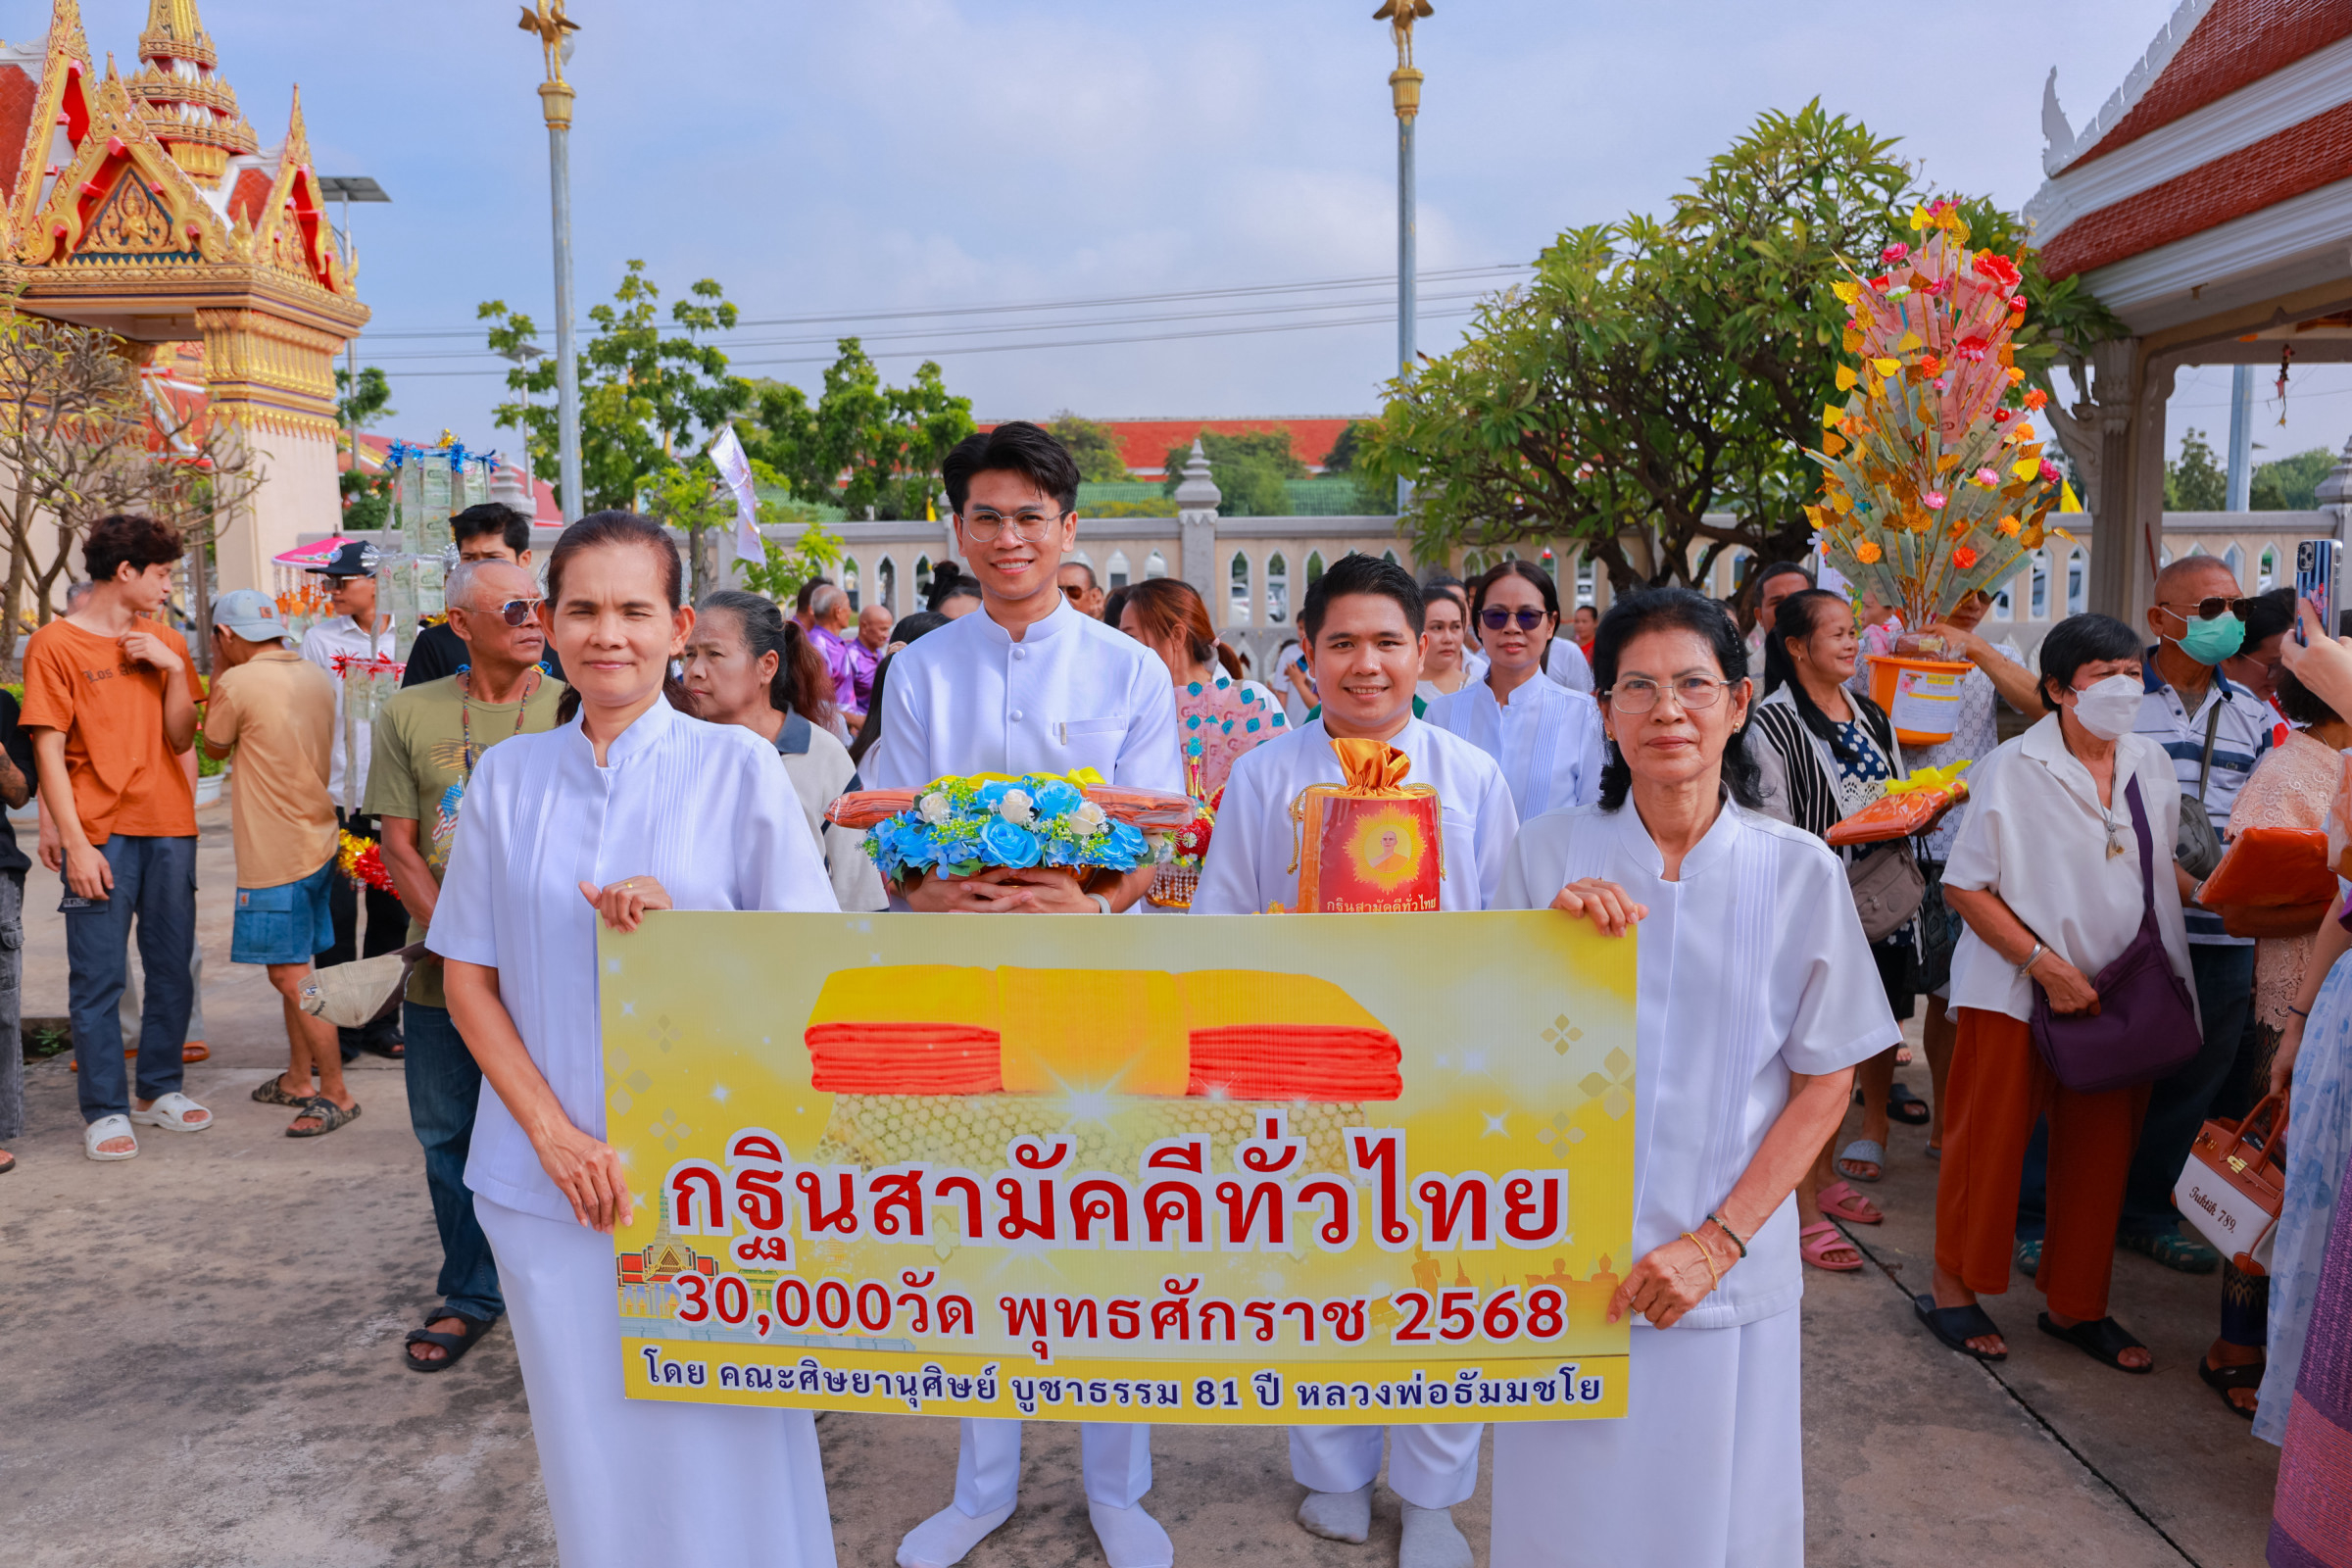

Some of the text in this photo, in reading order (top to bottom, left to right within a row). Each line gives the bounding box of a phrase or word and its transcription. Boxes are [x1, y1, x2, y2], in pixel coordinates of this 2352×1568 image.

[83, 668, 114, 683] Los
[671, 1118, 1559, 1262] กฐินสามัคคีทั่วไทย
[677, 1271, 1564, 1361] 30,000วัด พุทธศักราช 2568
[643, 1348, 1599, 1413] โดย คณะศิษยานุศิษย์ บูชาธรรม 81 ปี หลวงพ่อธัมมชโย
